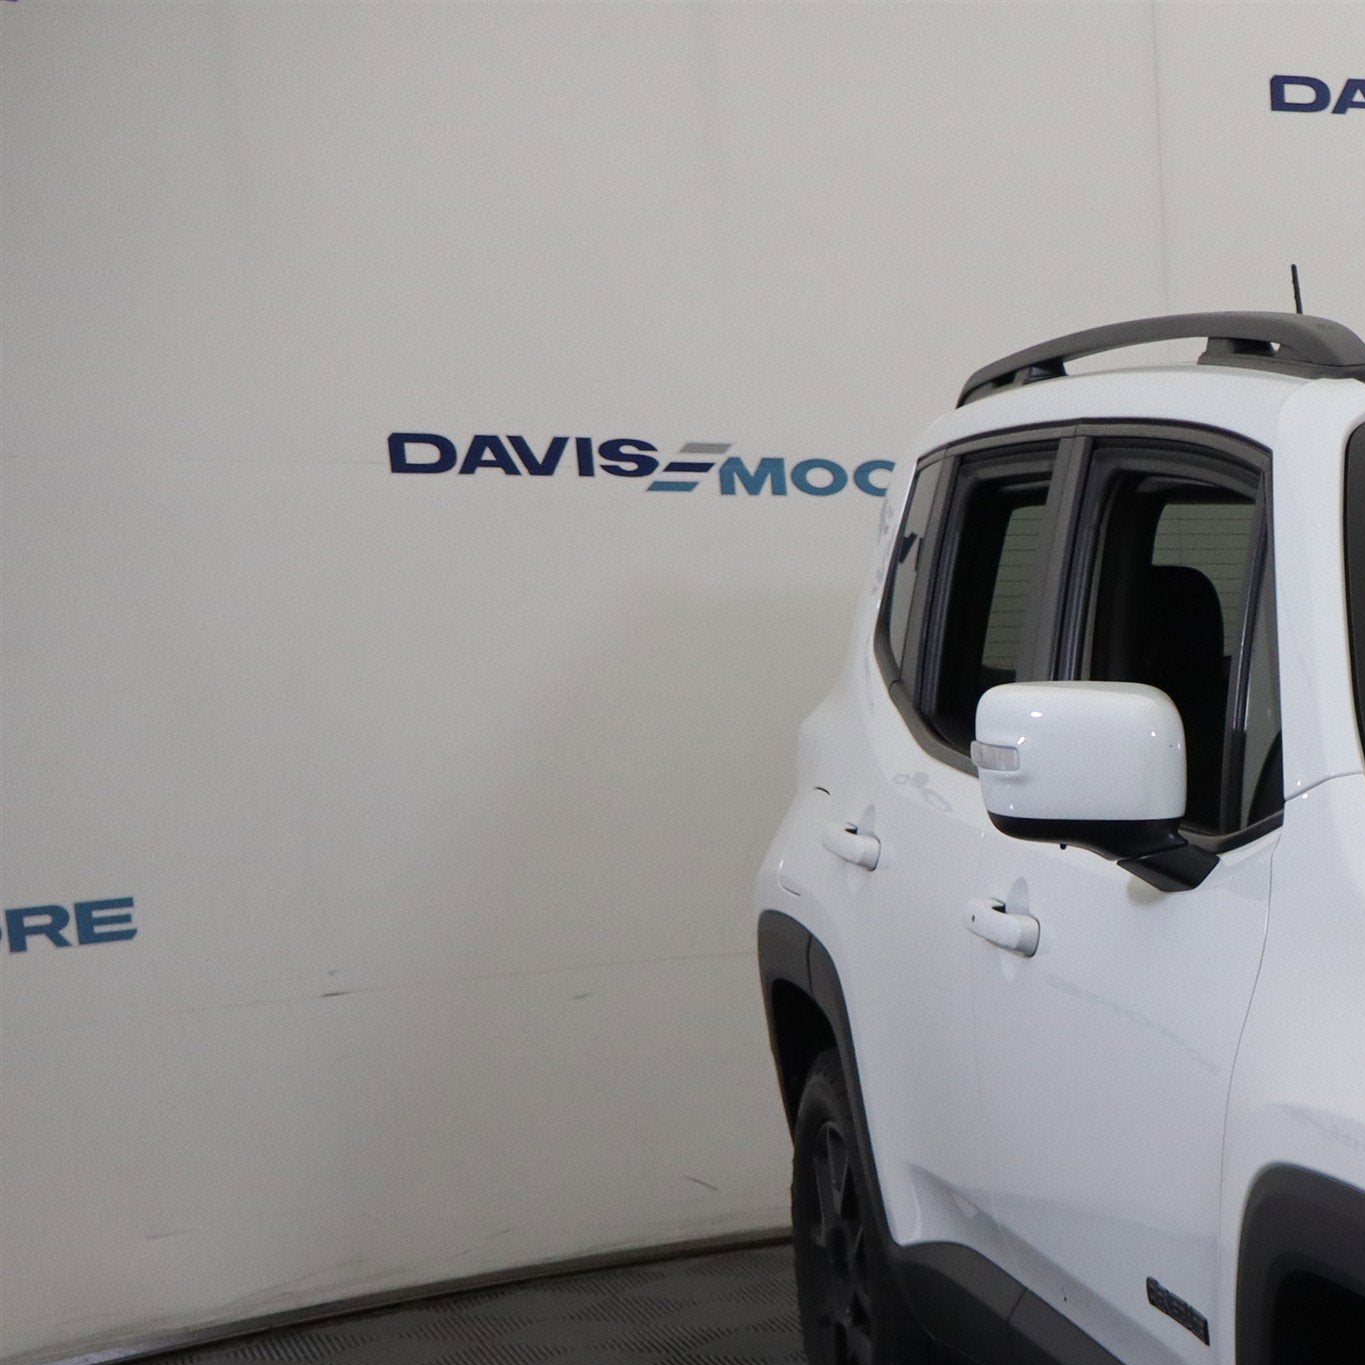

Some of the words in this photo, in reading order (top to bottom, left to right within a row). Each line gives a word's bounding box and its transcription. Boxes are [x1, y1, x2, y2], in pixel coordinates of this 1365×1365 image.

[386, 431, 659, 478] DAVIS
[718, 456, 895, 497] MOO
[0, 896, 138, 954] RE
